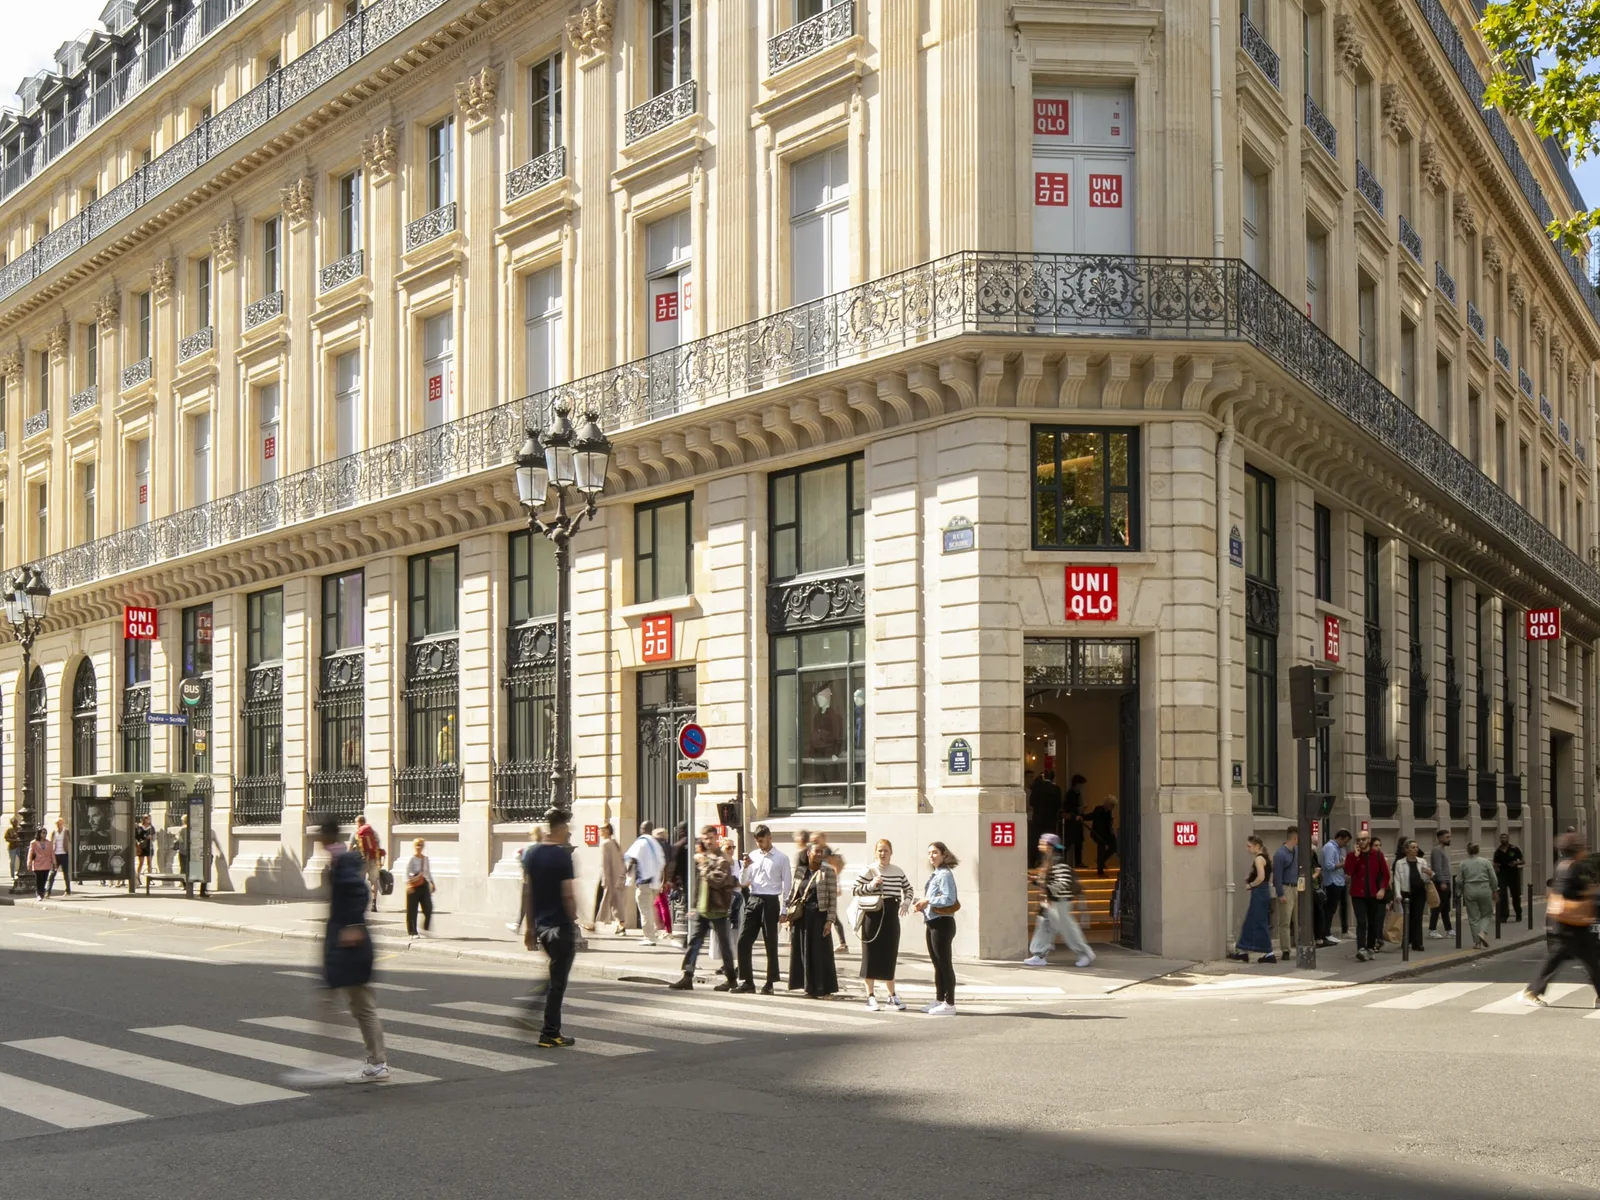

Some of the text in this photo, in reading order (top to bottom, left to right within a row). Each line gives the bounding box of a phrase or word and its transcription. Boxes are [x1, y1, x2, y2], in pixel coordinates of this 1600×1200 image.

[1037, 103, 1062, 116] UNI
[1037, 118, 1065, 132] QLO
[1039, 176, 1064, 188] ユニ
[1092, 178, 1116, 190] UNI
[1038, 190, 1064, 202] クロ
[1093, 191, 1119, 205] QLO
[659, 295, 677, 307] ユニ
[658, 307, 677, 319] クロ
[1071, 573, 1108, 591] UNI
[1071, 595, 1112, 616] QLO
[129, 610, 152, 623] UNI
[1530, 612, 1554, 624] UNI
[129, 623, 154, 636] QLO
[645, 620, 667, 637] ユニ
[1530, 624, 1556, 638] QLO
[644, 638, 667, 655] クロ
[184, 685, 199, 694] BUS
[995, 825, 1012, 833] ユニ
[1177, 824, 1194, 833] UNI
[994, 835, 1012, 843] クロ
[1177, 834, 1195, 844] QLO
